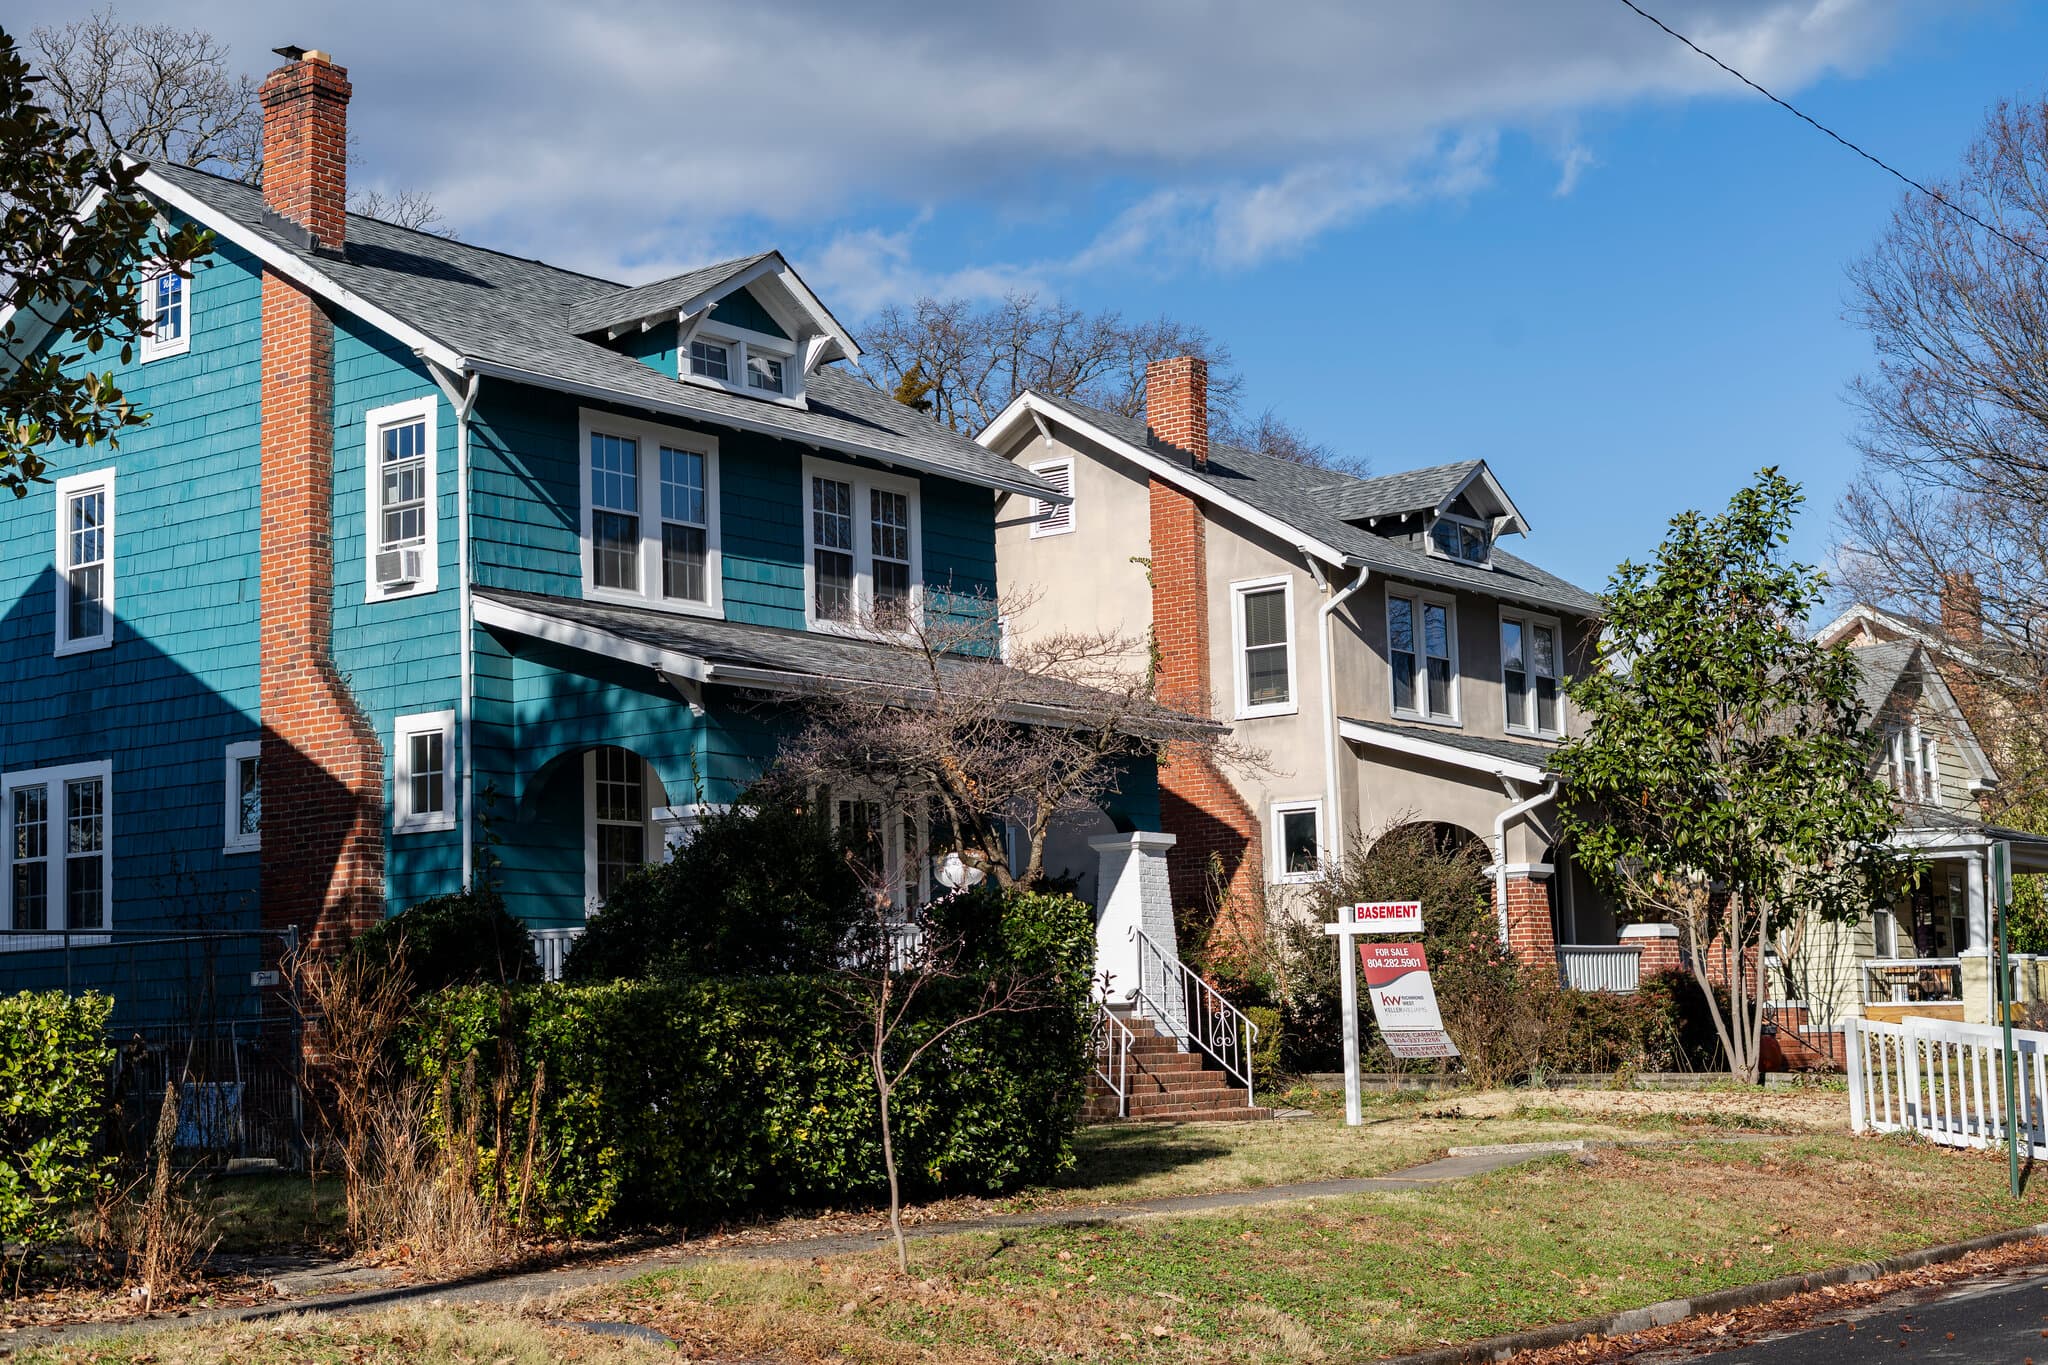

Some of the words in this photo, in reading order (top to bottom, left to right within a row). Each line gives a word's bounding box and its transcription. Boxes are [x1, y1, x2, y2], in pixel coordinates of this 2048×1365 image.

[1357, 905, 1418, 919] BASEMENT
[1375, 948, 1390, 957] FOR
[1391, 947, 1409, 956] SALE
[1367, 958, 1421, 968] 804.282.5901
[1380, 991, 1401, 1006] kw
